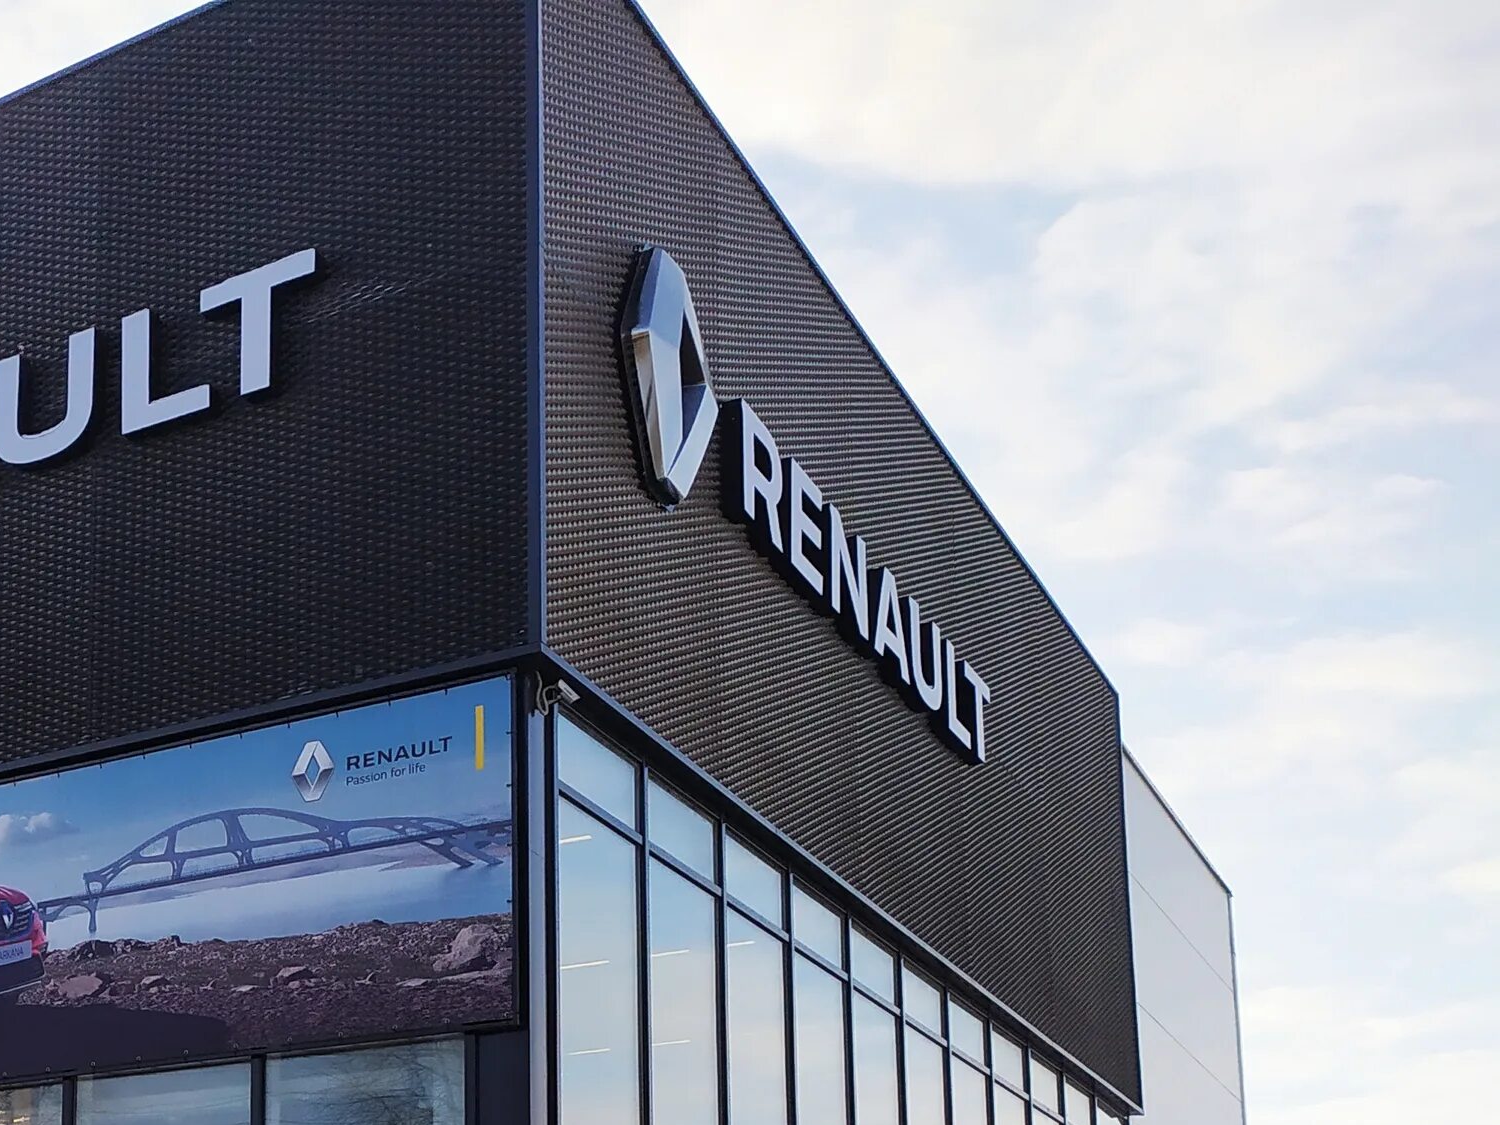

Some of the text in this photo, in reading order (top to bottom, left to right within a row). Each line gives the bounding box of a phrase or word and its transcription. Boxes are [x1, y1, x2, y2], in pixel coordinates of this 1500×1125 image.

[740, 397, 991, 764] RENAULT
[346, 736, 452, 771] RENAULT
[346, 761, 426, 786] Passion for life
